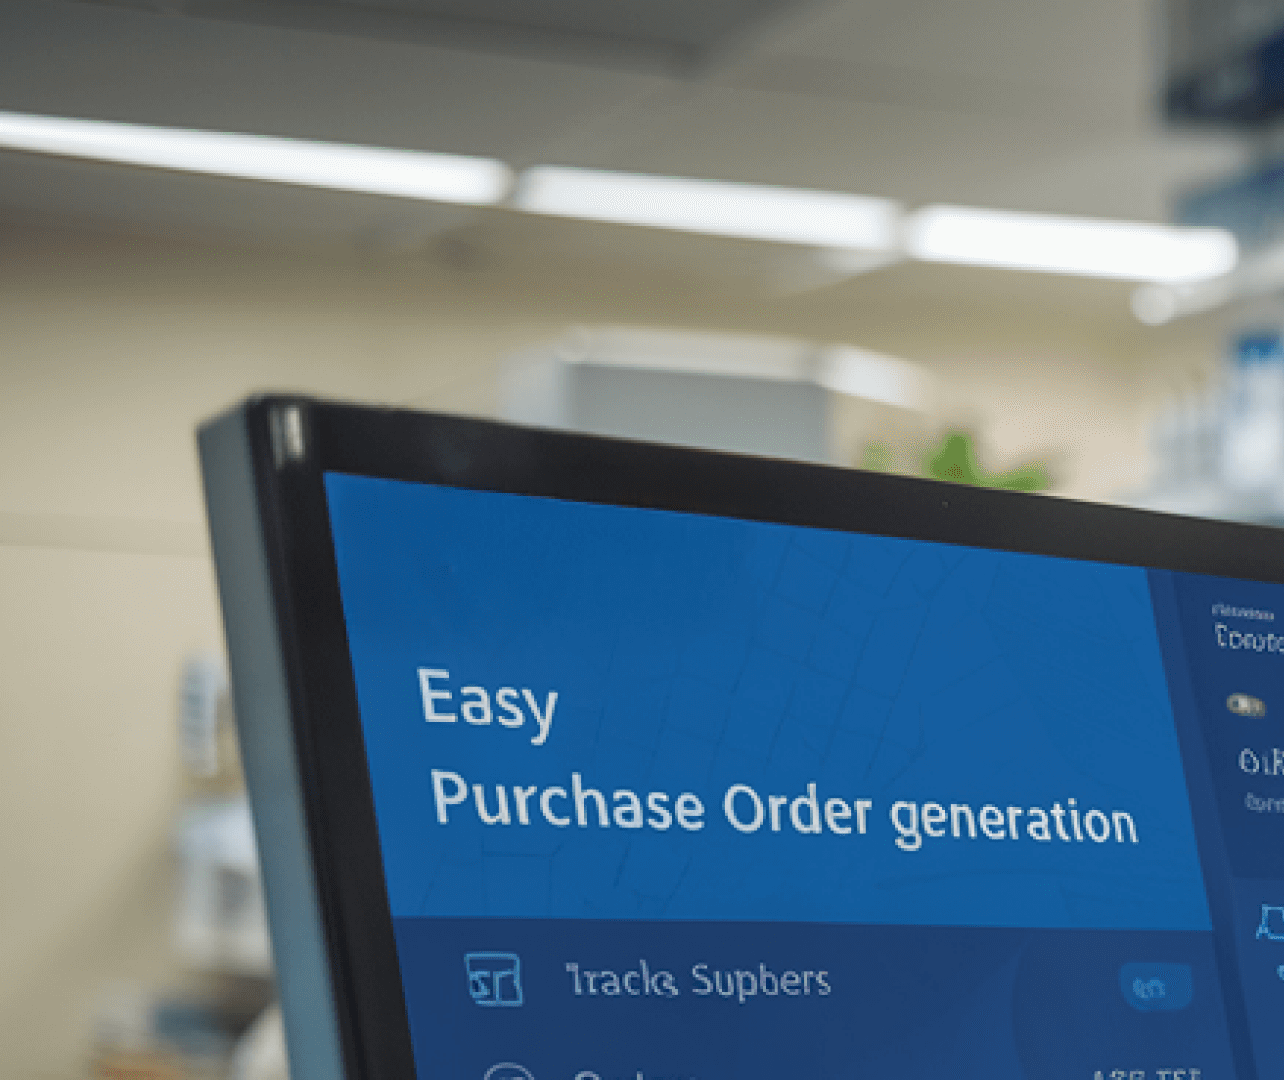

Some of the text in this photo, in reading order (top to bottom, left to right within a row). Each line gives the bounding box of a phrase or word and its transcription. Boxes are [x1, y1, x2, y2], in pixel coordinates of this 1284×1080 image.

[417, 666, 559, 746] Easy
[431, 768, 1140, 851] Purchase Order generation
